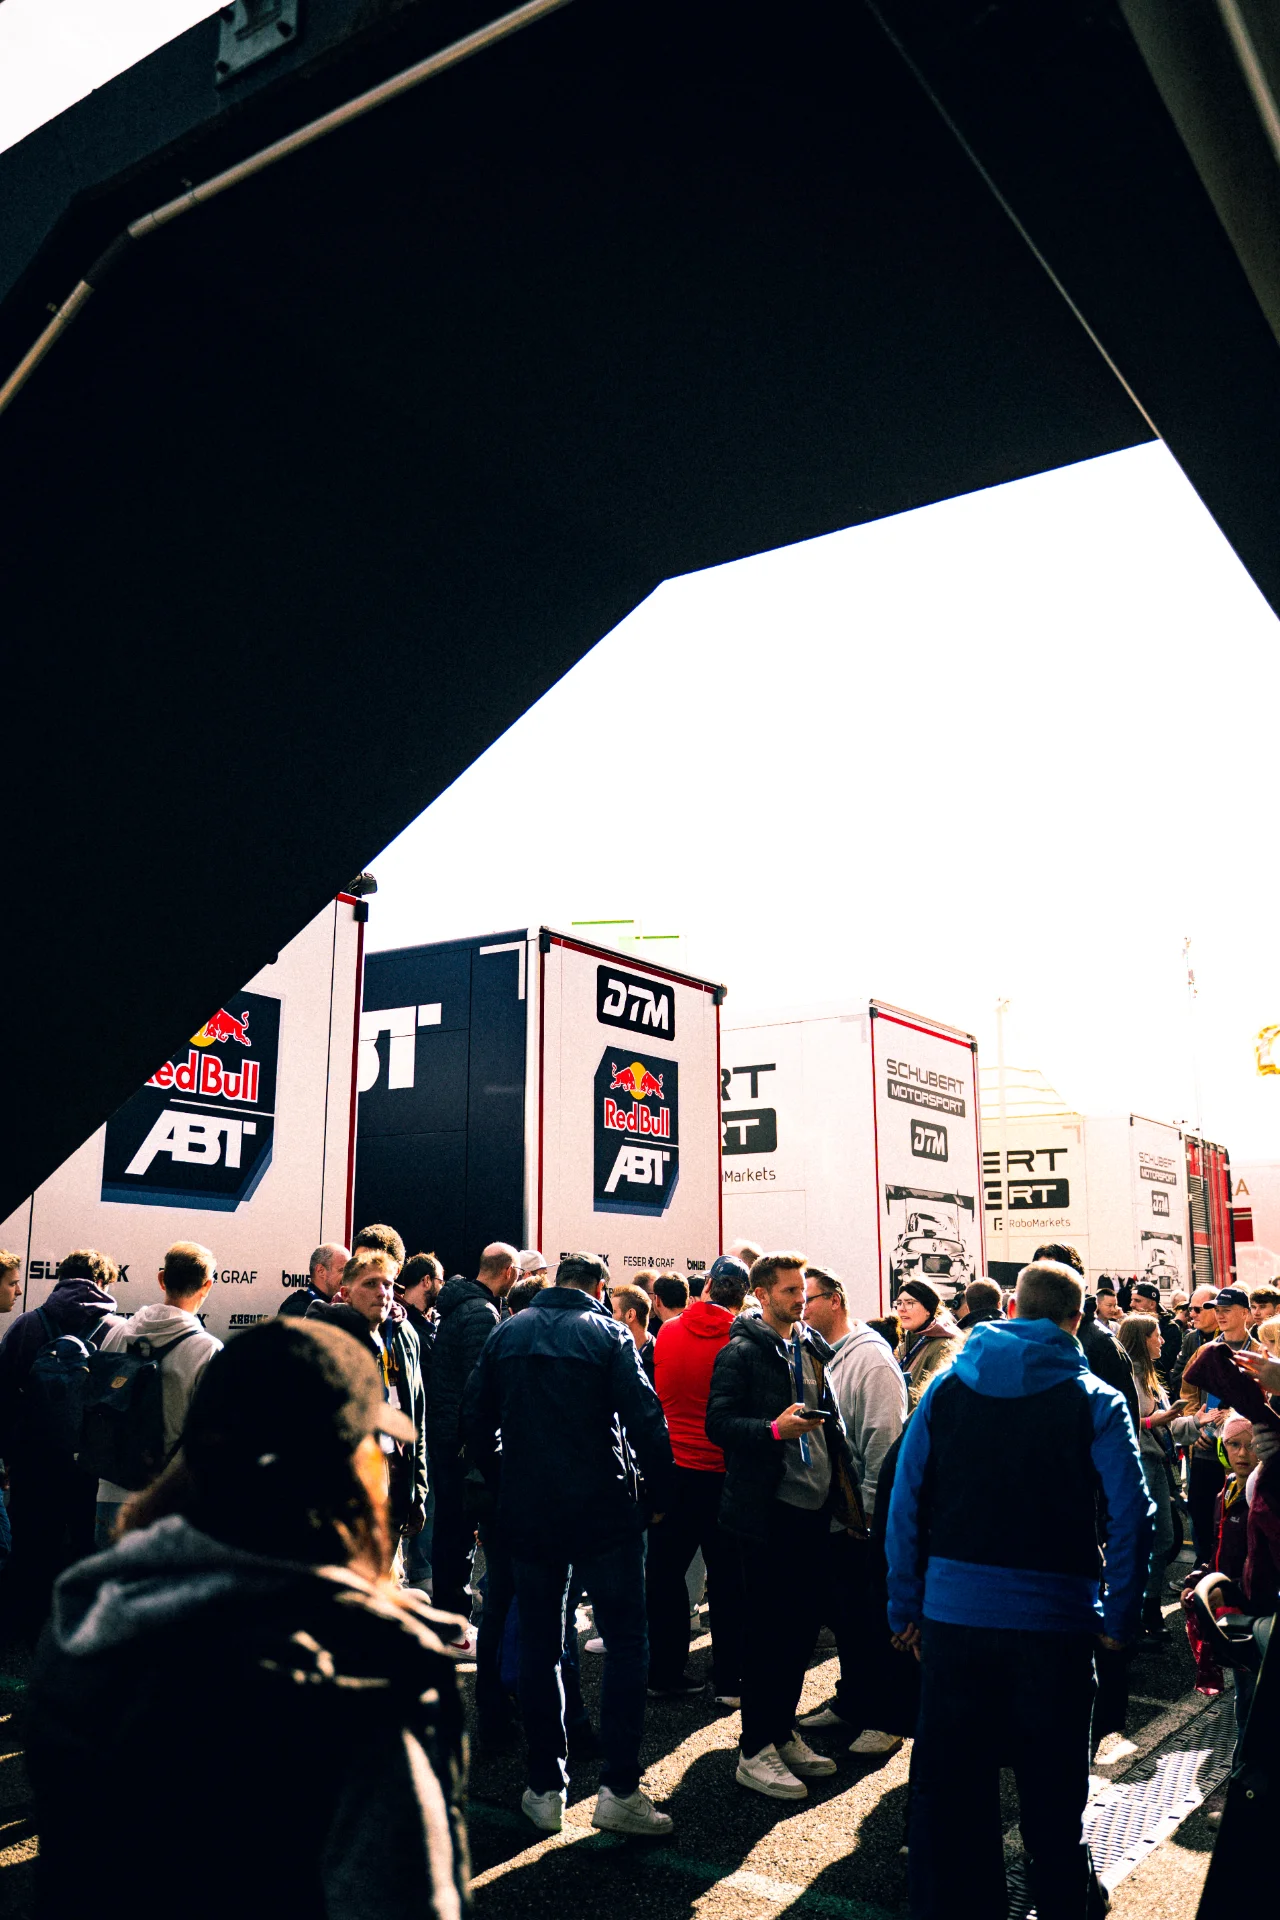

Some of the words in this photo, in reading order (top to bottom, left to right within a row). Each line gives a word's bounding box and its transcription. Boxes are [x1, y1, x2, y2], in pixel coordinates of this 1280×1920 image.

[603, 978, 669, 1031] DTM
[144, 1049, 199, 1093] ed
[886, 1058, 964, 1095] SCHUBERT
[891, 1083, 963, 1114] MOTORSPORT
[603, 1097, 638, 1133] Red
[638, 1102, 670, 1139] Bull
[124, 1109, 257, 1176] ABT
[913, 1125, 946, 1156] DTM
[604, 1145, 670, 1193] ABT
[721, 1167, 777, 1183] Markets
[1139, 1151, 1176, 1168] SCHUBERT
[1141, 1168, 1176, 1184] MOTORSPORT
[1009, 1217, 1071, 1229] RoboMarkets
[623, 1255, 647, 1267] FESER
[655, 1257, 675, 1268] GRAF
[221, 1270, 258, 1285] GRAF
